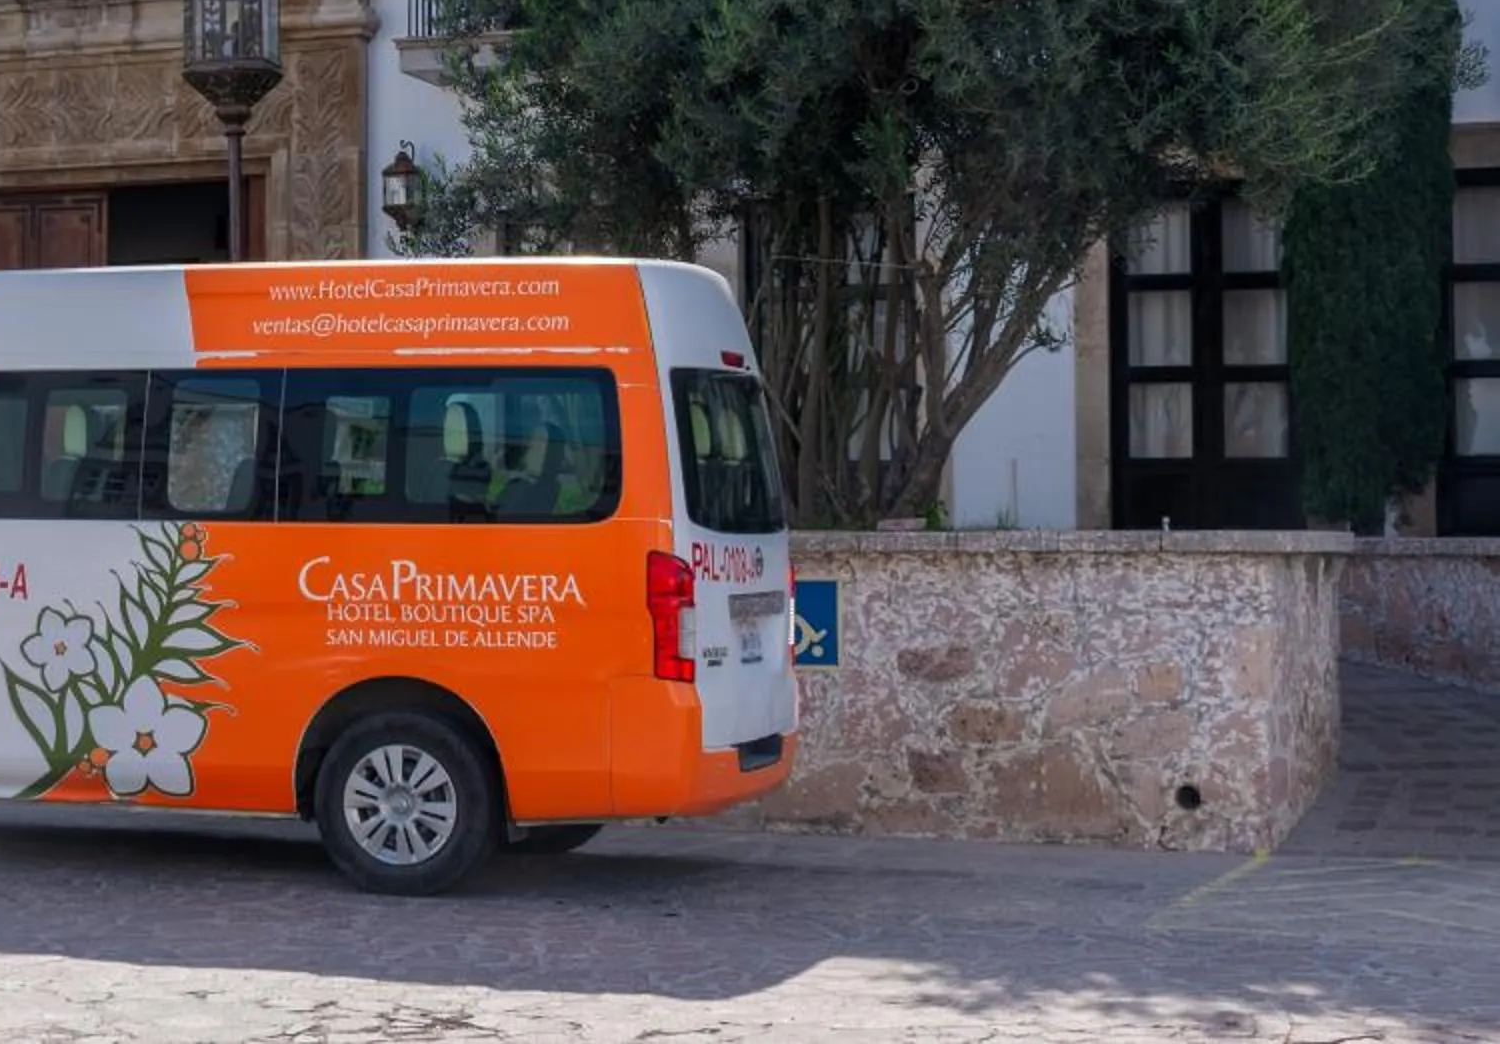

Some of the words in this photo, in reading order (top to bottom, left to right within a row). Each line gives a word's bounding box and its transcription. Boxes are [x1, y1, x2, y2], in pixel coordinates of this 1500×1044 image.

[269, 277, 559, 300] www.HotelCasaPrimavera.com
[252, 312, 569, 339] ventas@hotelcasaprimavera.com
[327, 604, 395, 622] HOTEL
[402, 604, 512, 627] BOUTIQUE
[518, 605, 555, 624] SPA
[325, 629, 363, 645] SAN
[369, 630, 439, 647] MIGUEL
[445, 631, 468, 648] DE
[473, 630, 557, 649] ALLENDE
